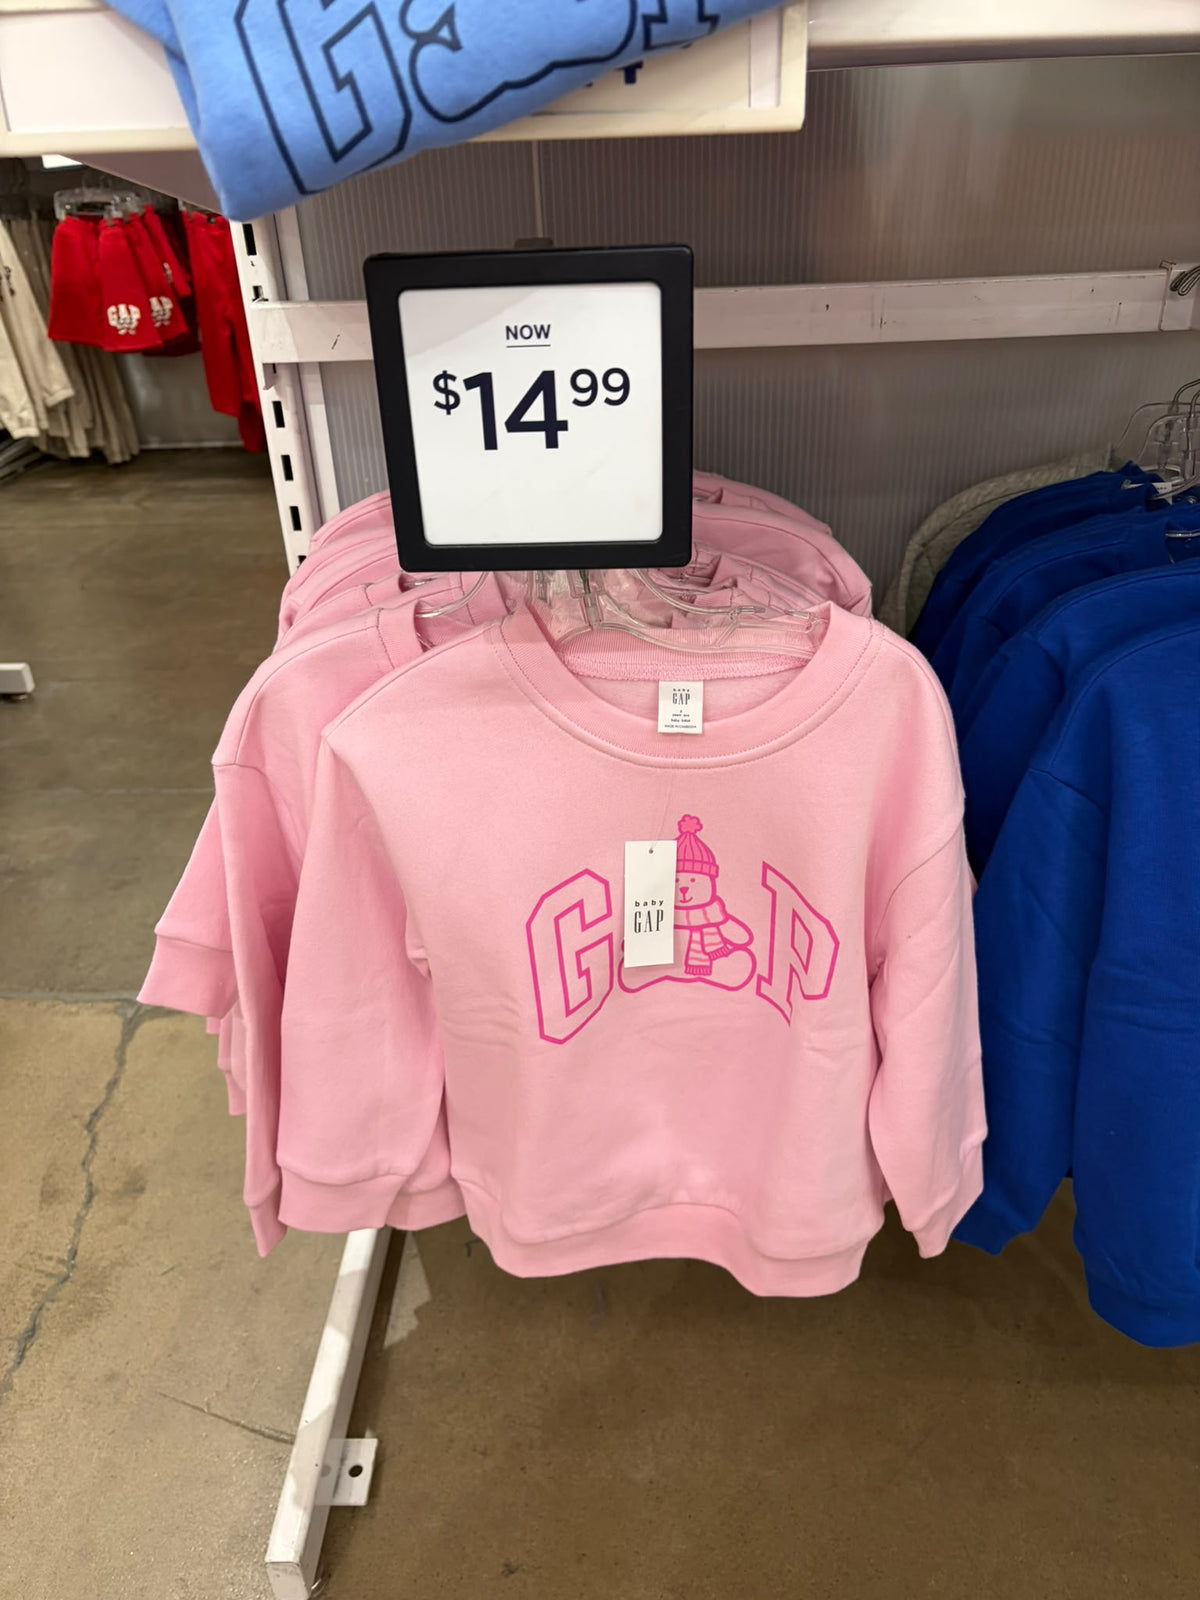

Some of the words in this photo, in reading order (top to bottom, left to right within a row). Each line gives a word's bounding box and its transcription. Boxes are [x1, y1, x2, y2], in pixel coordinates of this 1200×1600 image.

[505, 324, 551, 340] NOW
[672, 692, 690, 705] GAP
[634, 909, 664, 933] GAP
[526, 861, 840, 1045] GP
